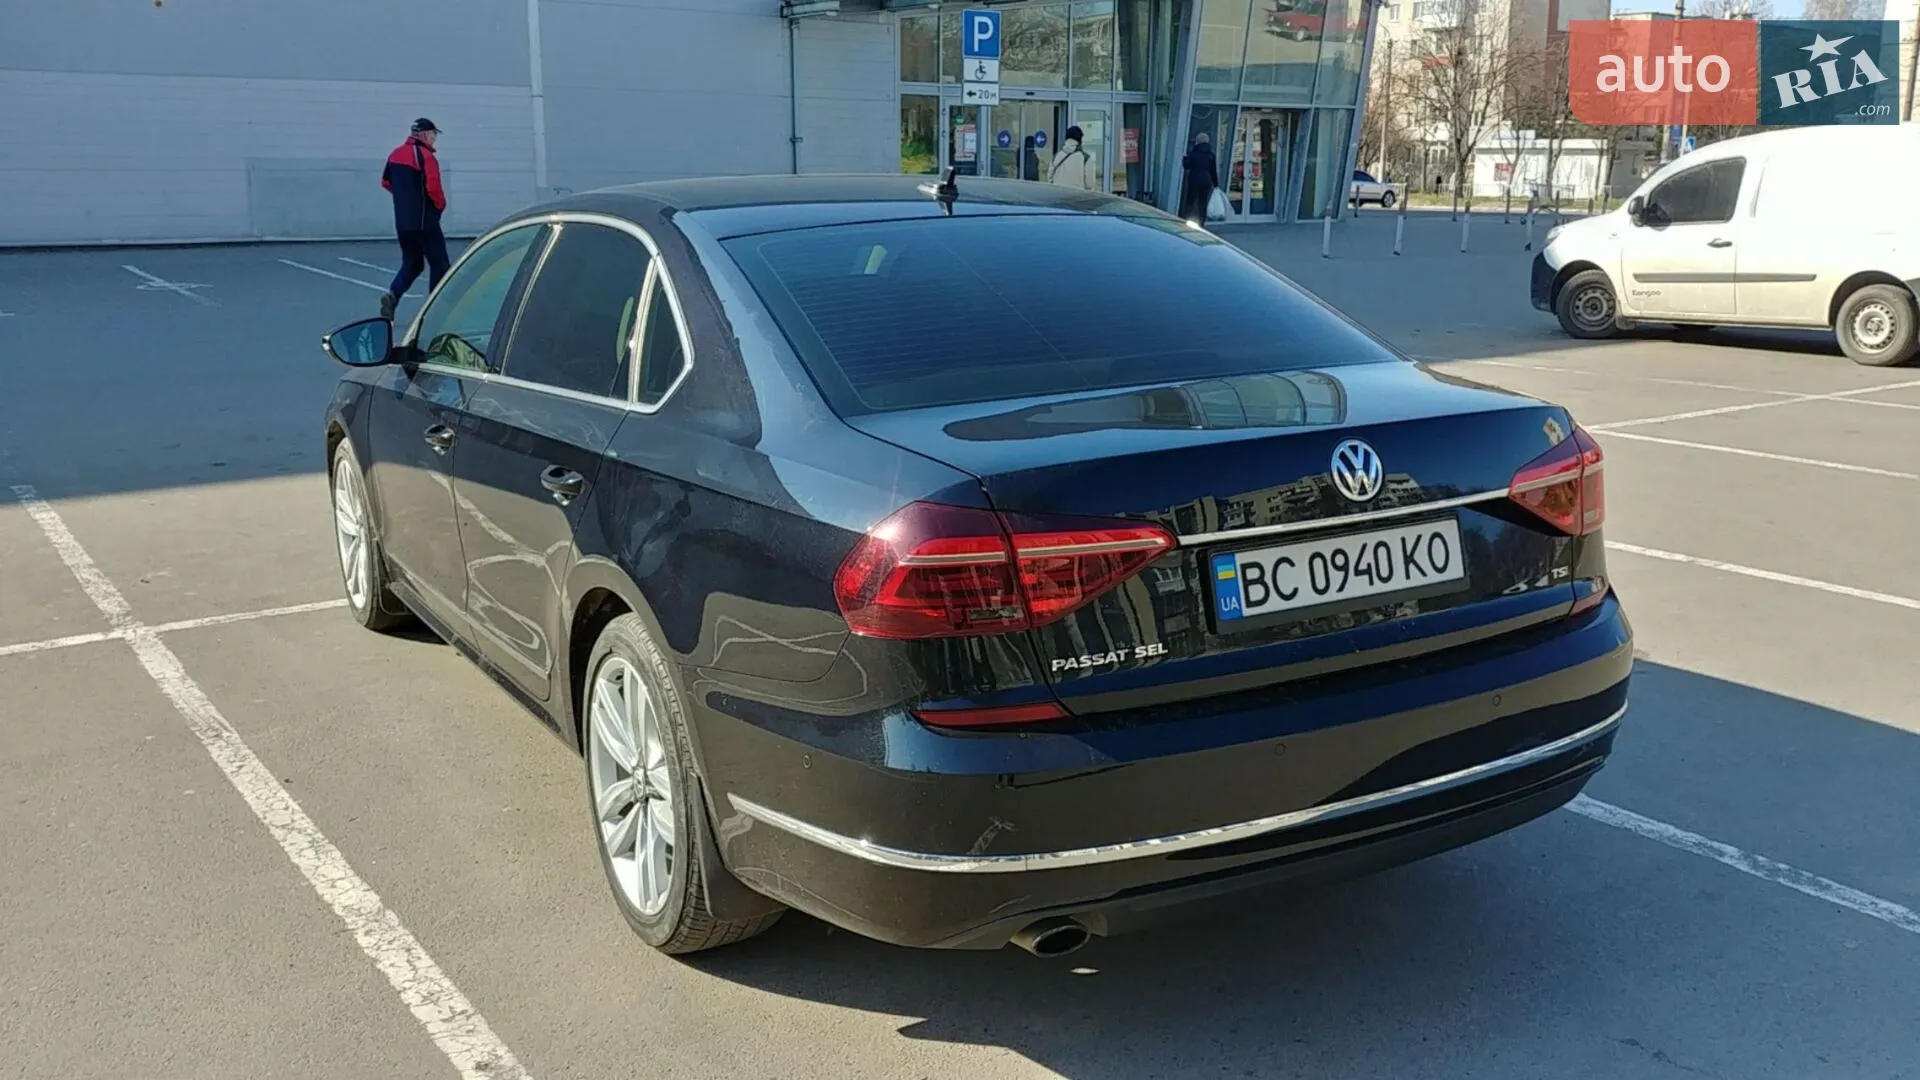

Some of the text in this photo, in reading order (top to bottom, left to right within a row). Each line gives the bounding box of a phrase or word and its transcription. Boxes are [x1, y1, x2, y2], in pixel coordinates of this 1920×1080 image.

[974, 16, 993, 52] P
[1239, 531, 1450, 609] BC 0940 KO
[1220, 596, 1240, 612] UA
[1051, 643, 1169, 672] PASSAT SEL
